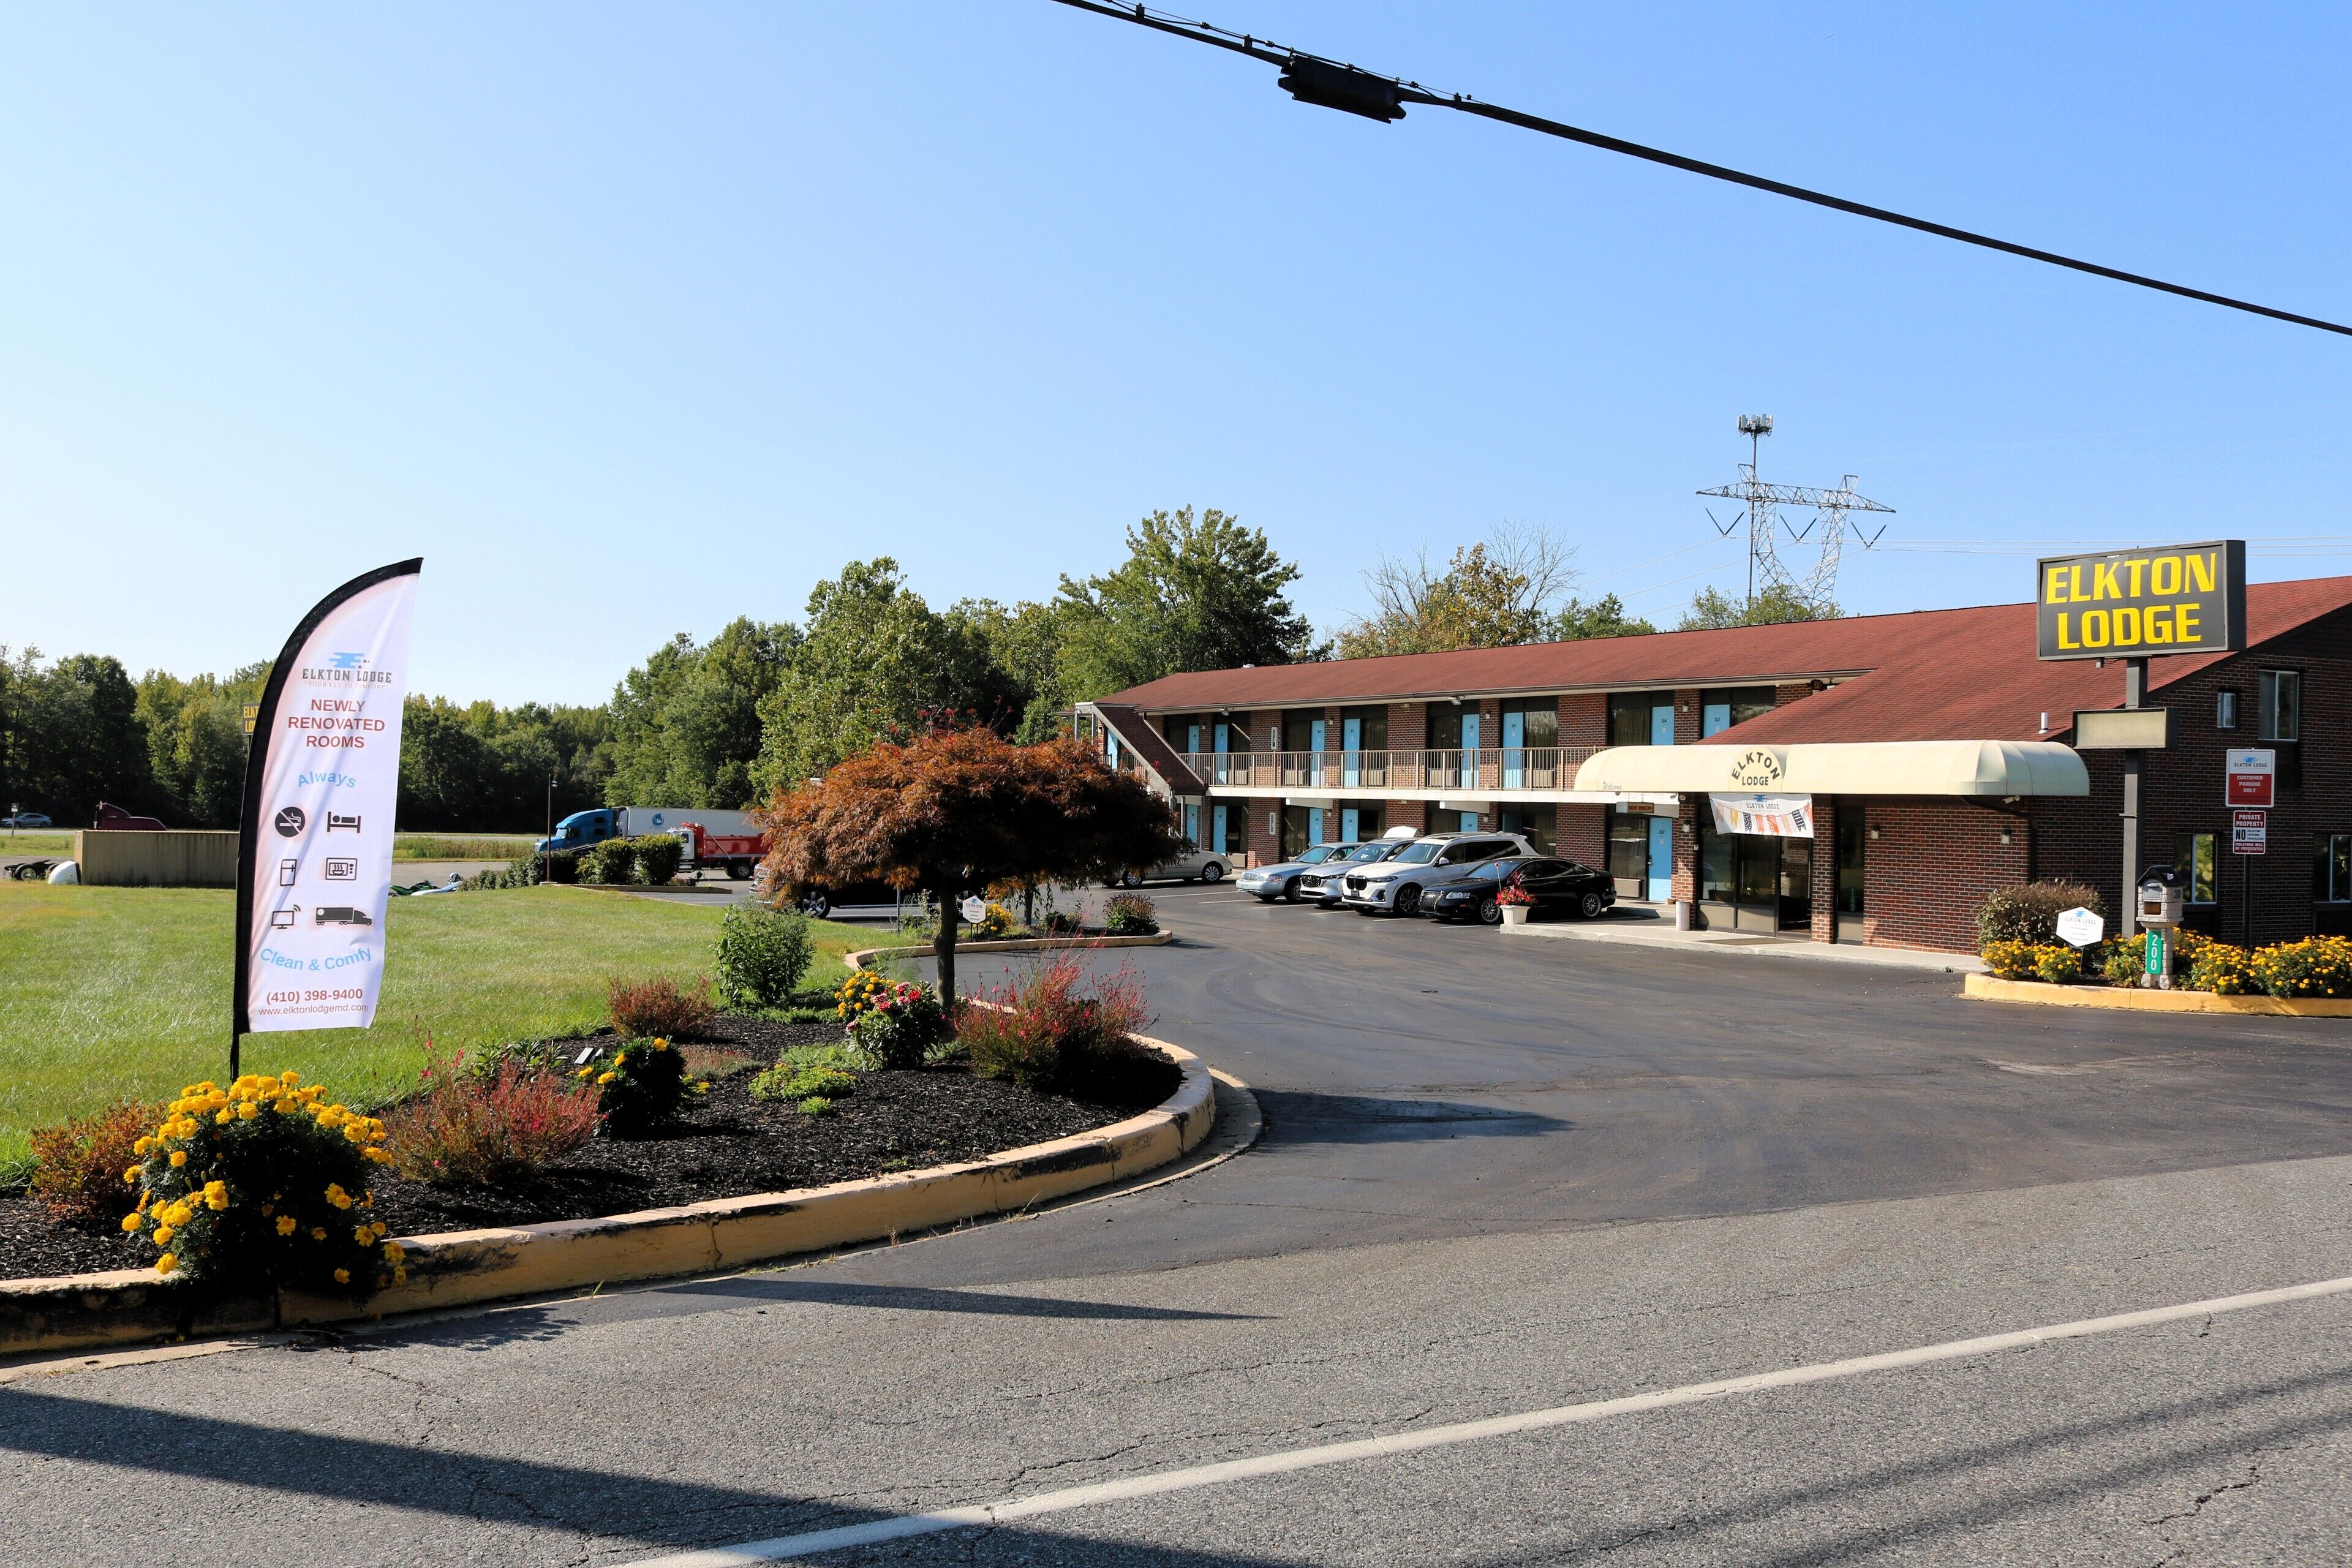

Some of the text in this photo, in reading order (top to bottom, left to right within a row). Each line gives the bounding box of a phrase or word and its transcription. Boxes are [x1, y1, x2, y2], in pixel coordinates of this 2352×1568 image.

[2046, 552, 2217, 605] ELKTON
[2057, 603, 2202, 650] LODGE
[302, 668, 392, 683] ELKTON LODGE
[243, 706, 259, 718] ELKT
[311, 699, 366, 712] NEWLY
[288, 717, 385, 731] RENOVATED
[306, 735, 364, 748] ROOMS
[1732, 752, 1780, 780] ELKTON
[298, 771, 356, 788] Always
[1602, 782, 1622, 790] Welcome
[1742, 776, 1769, 786] LODGE
[2236, 829, 2246, 840] NO
[260, 948, 372, 971] Clean & Comfy
[266, 988, 363, 1005] (410) 398-9400
[258, 1004, 368, 1016] www.elktonlodgemd.com
